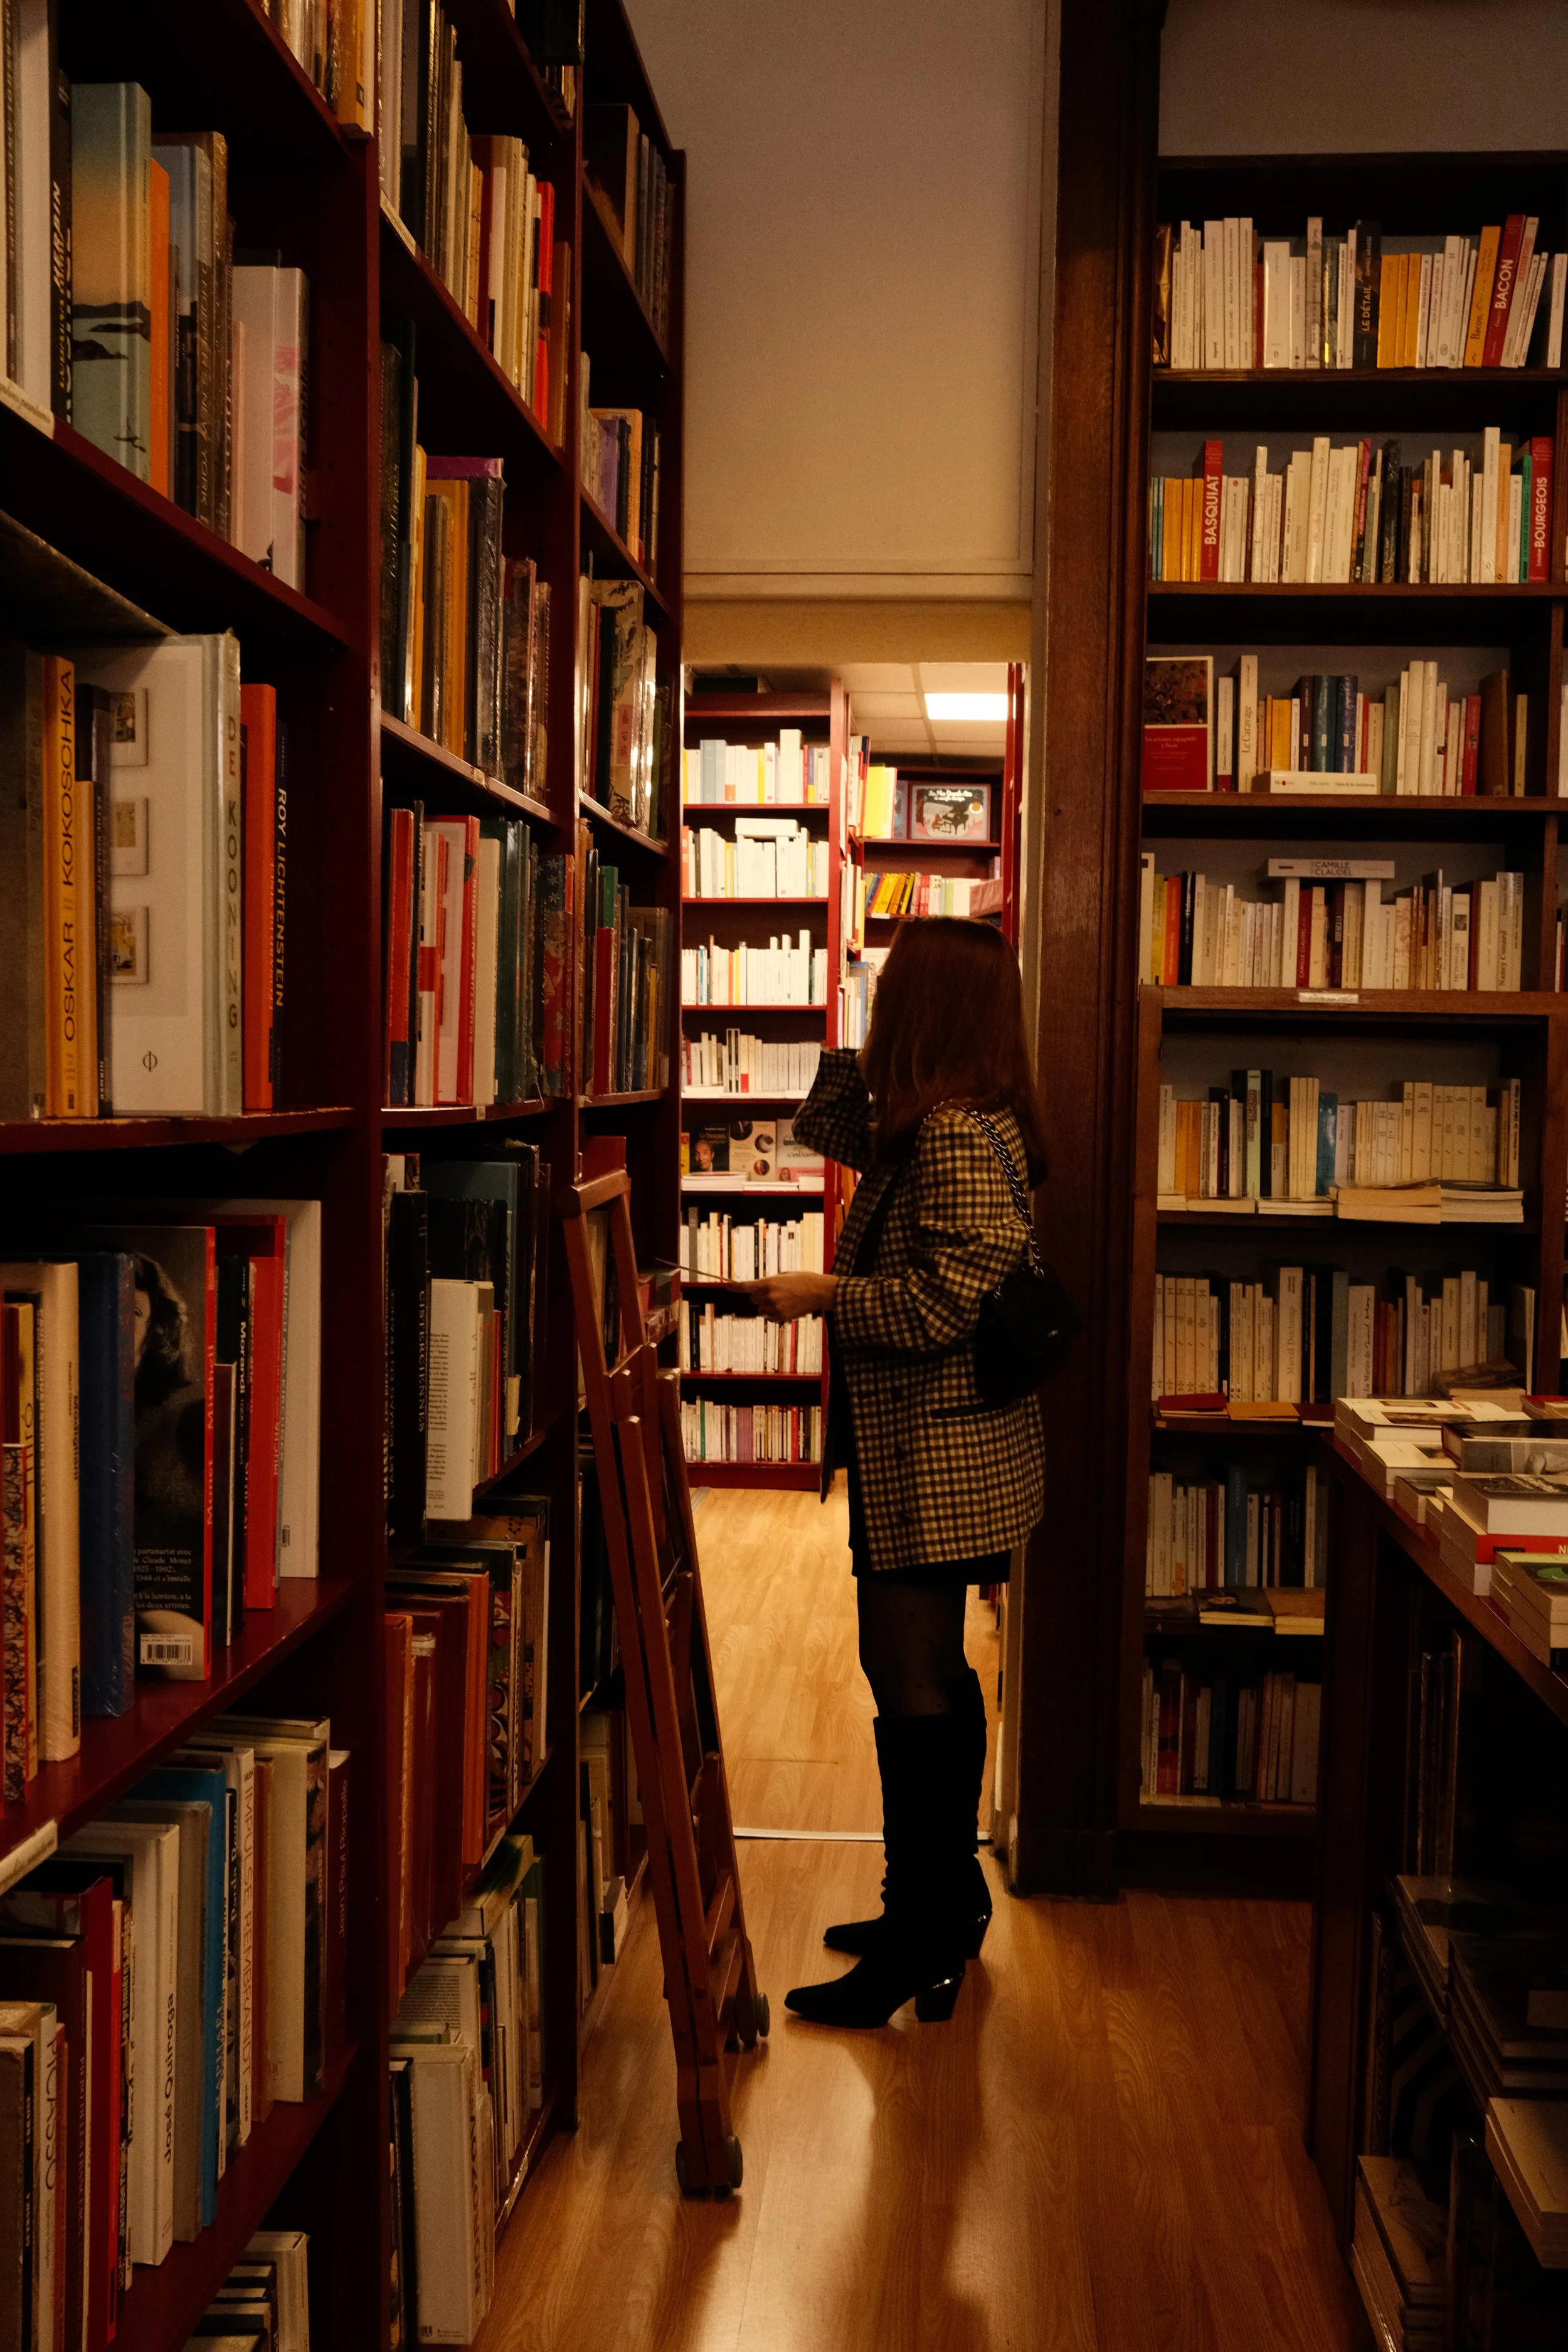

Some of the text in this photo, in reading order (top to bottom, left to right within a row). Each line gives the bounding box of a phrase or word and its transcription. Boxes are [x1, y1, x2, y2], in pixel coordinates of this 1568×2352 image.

[1360, 285, 1372, 332] LE DÉTAIL
[1494, 259, 1513, 309] BACON
[299, 359, 309, 524] Frida Kahlo
[1204, 474, 1219, 545] BASQUIAT
[1534, 476, 1548, 548] BOURGEOIS
[1241, 706, 1253, 753] Le Caravage
[60, 670, 75, 1042] OSKAR KOKOSCHKA
[228, 716, 238, 1029] DE KOONING
[275, 788, 287, 1007] ROY LICHTENSTEIN
[1498, 961, 1507, 986] Nancy
[1499, 930, 1508, 960] Cunard
[1287, 1306, 1296, 1374] Marcel Duchamp
[1558, 1544, 1568, 1555] N
[338, 1779, 348, 1937] Jean Paul Riopelle
[243, 1786, 253, 2075] IMPULSE REMBRANDT
[164, 1993, 175, 2099] Quiroga
[45, 2038, 58, 2190] PICASSO
[164, 2104, 172, 2164] José
